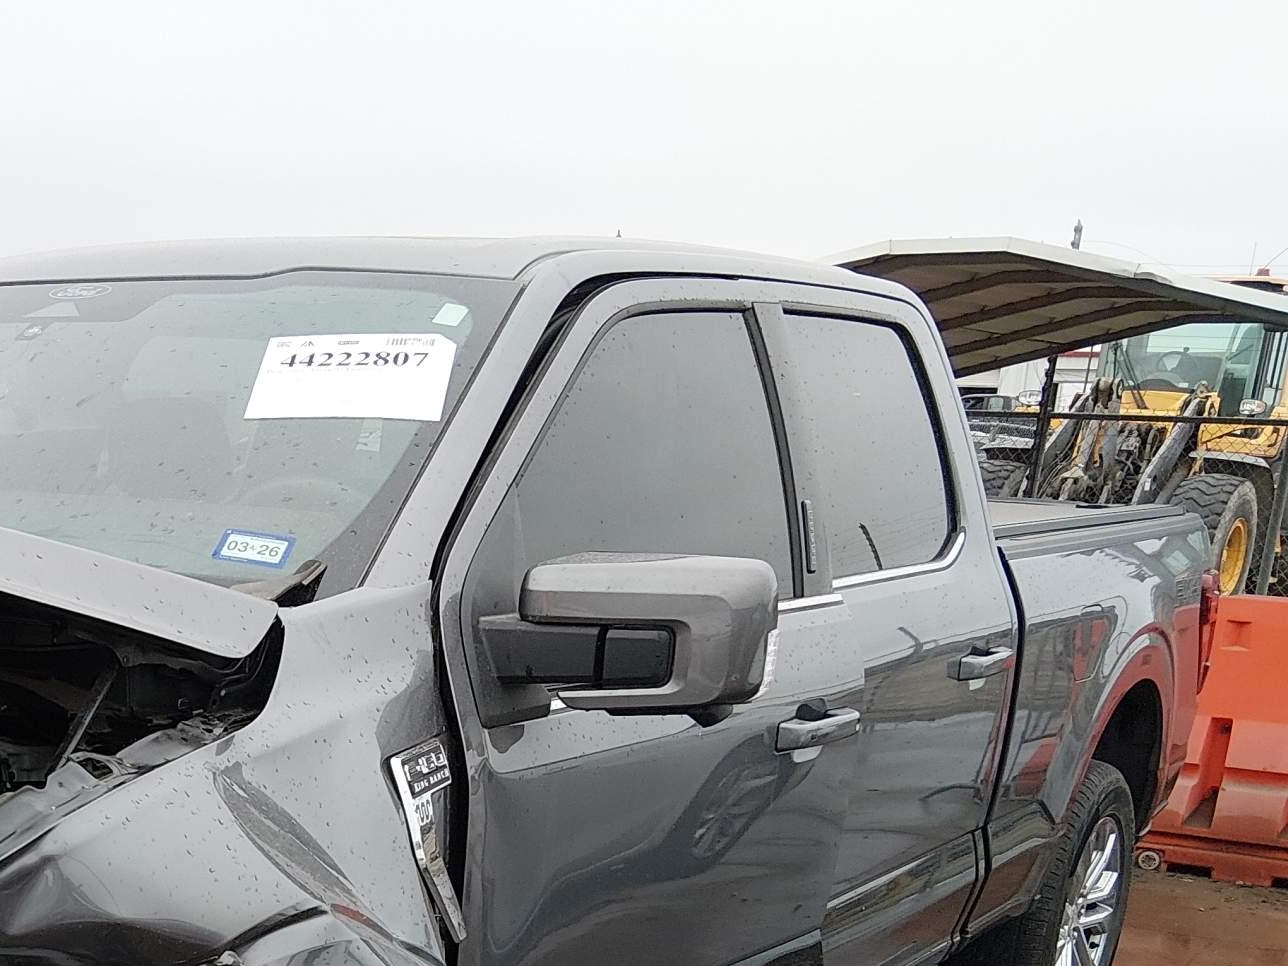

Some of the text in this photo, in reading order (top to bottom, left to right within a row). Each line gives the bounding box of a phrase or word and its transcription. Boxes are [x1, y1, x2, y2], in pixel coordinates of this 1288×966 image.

[279, 351, 429, 368] 44222807
[226, 540, 250, 553] 03
[256, 544, 281, 558] 26
